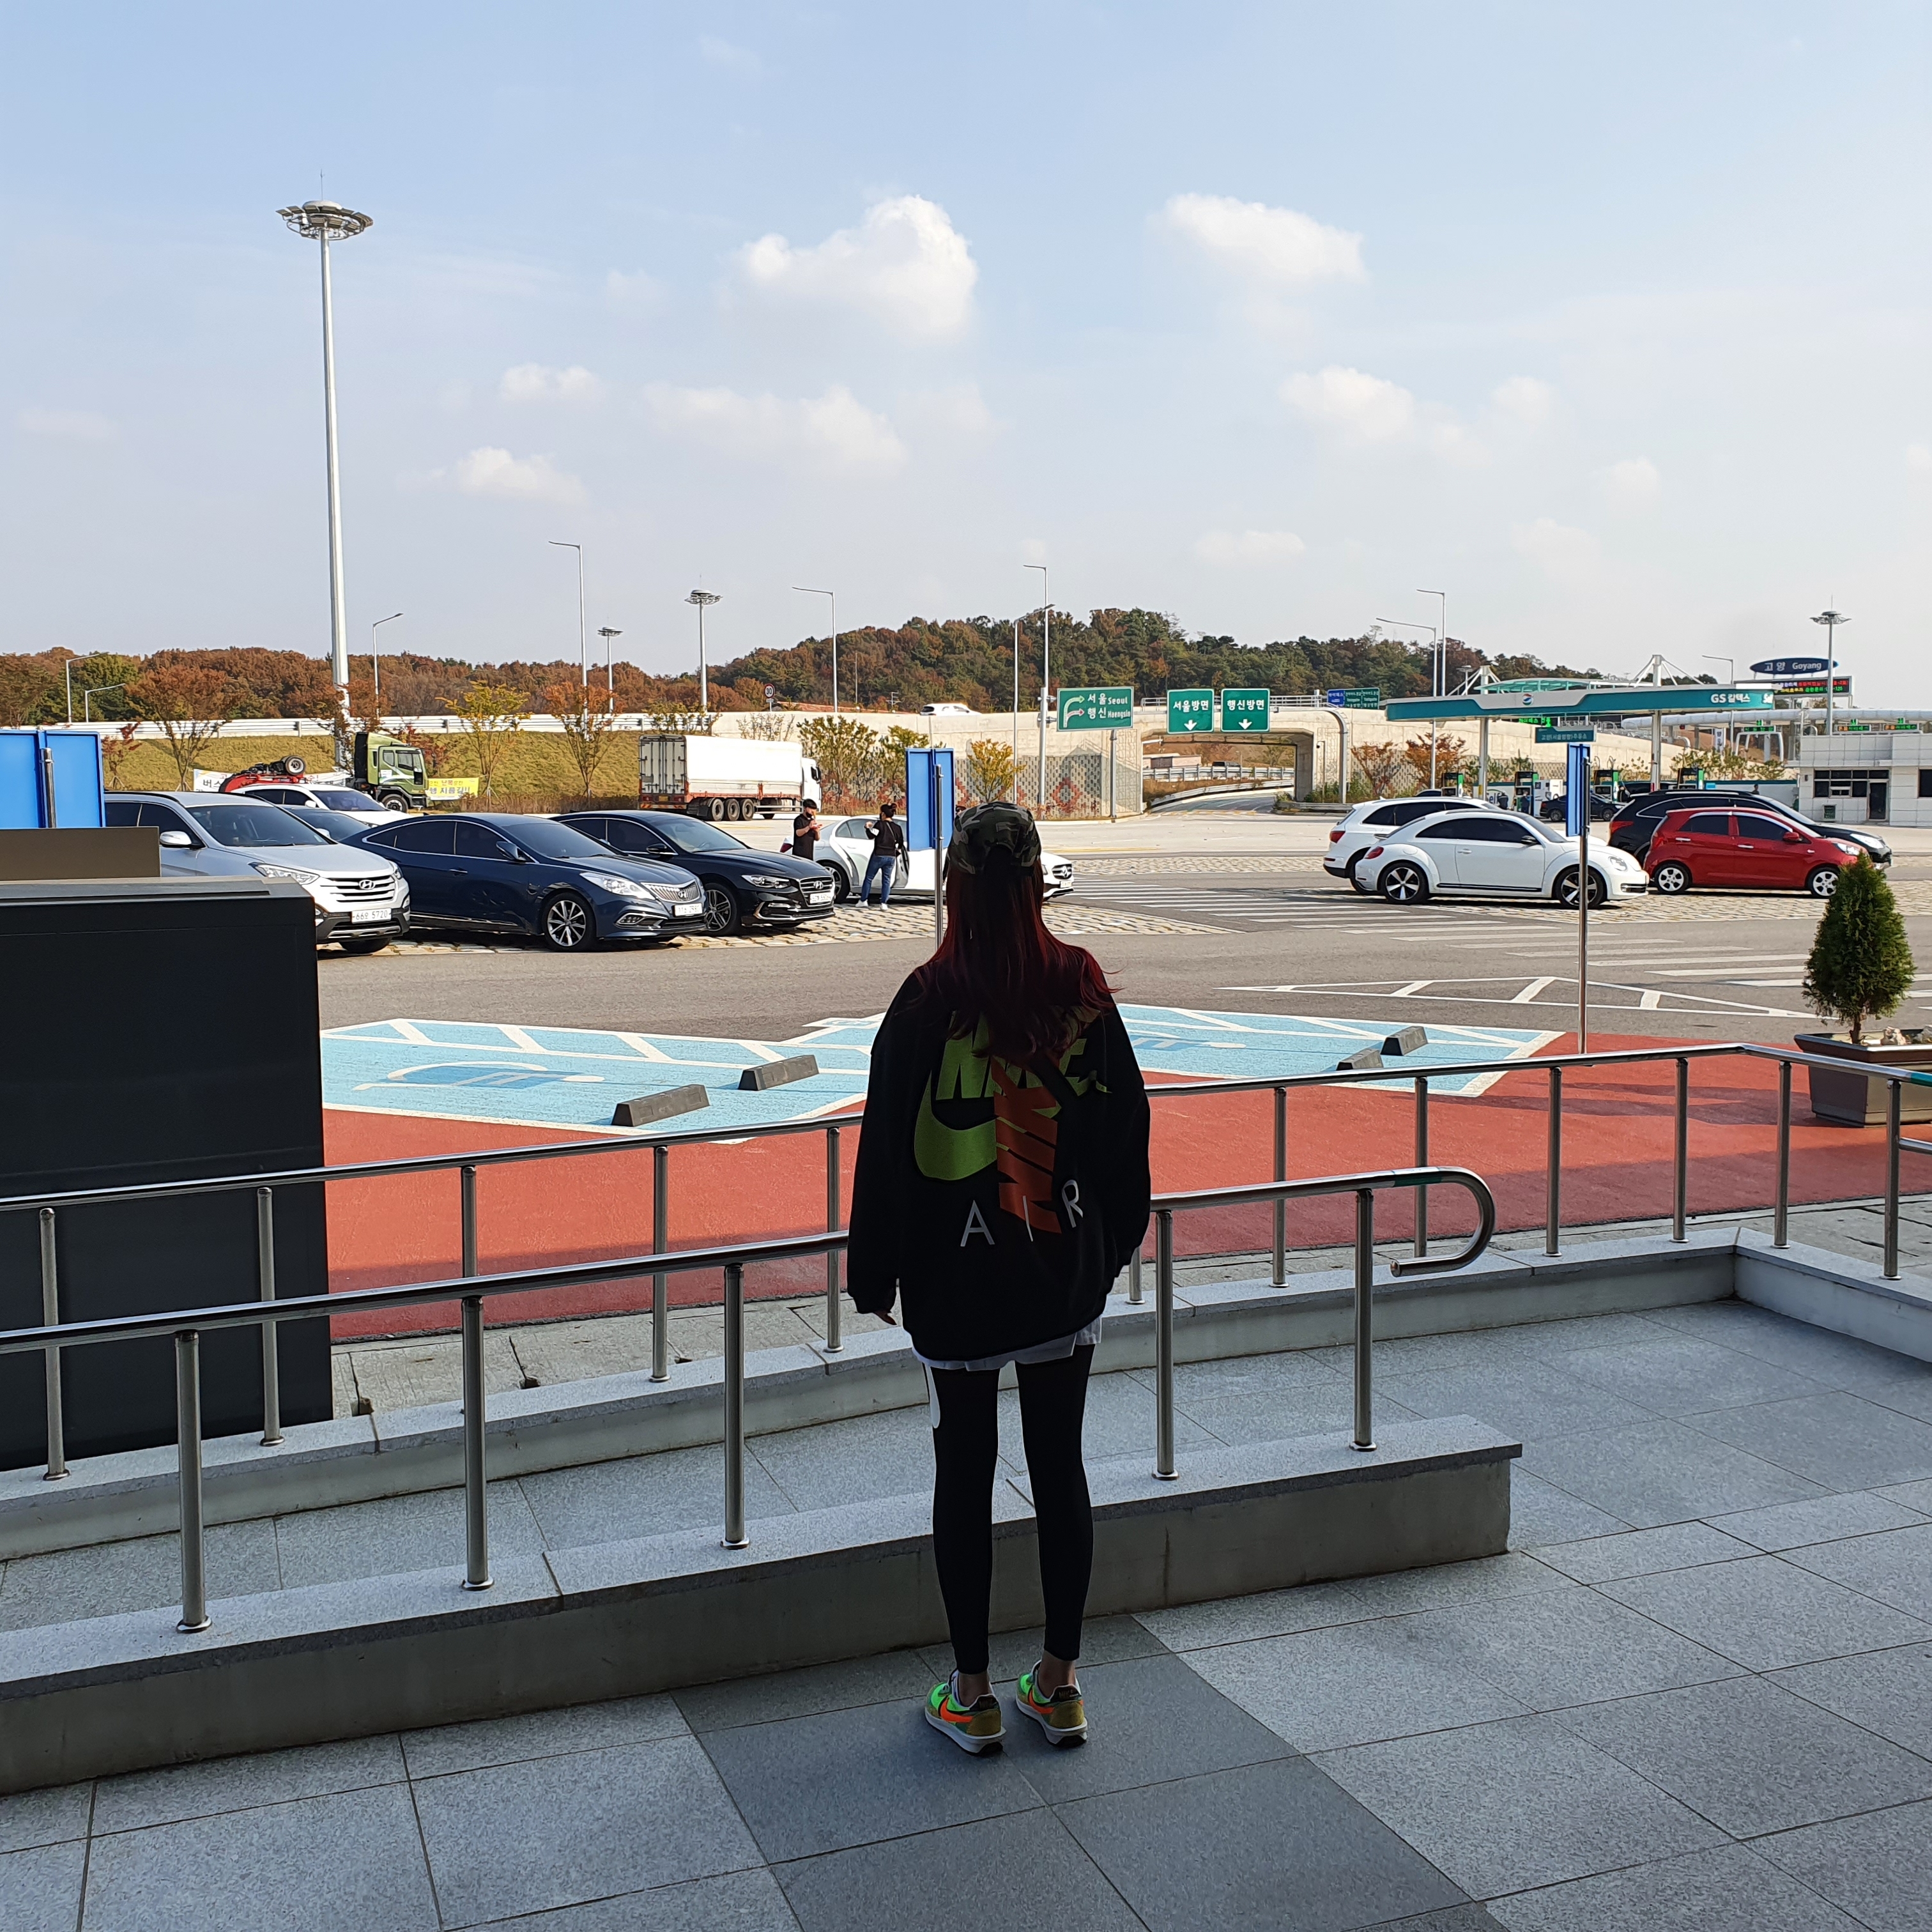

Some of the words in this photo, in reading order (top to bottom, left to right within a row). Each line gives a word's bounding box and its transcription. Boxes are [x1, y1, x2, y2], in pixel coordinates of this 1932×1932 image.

[1764, 661, 1786, 671] 고양
[1792, 663, 1822, 671] Goyang
[1087, 693, 1107, 705] 서울
[1108, 696, 1128, 705] Seoul
[1173, 700, 1209, 712] 서울방면
[1227, 700, 1265, 711] 행신방면
[1087, 707, 1107, 719] 행신
[1108, 710, 1131, 719] Haengsin
[372, 910, 388, 919] 5720
[960, 1179, 1084, 1248] AIR
